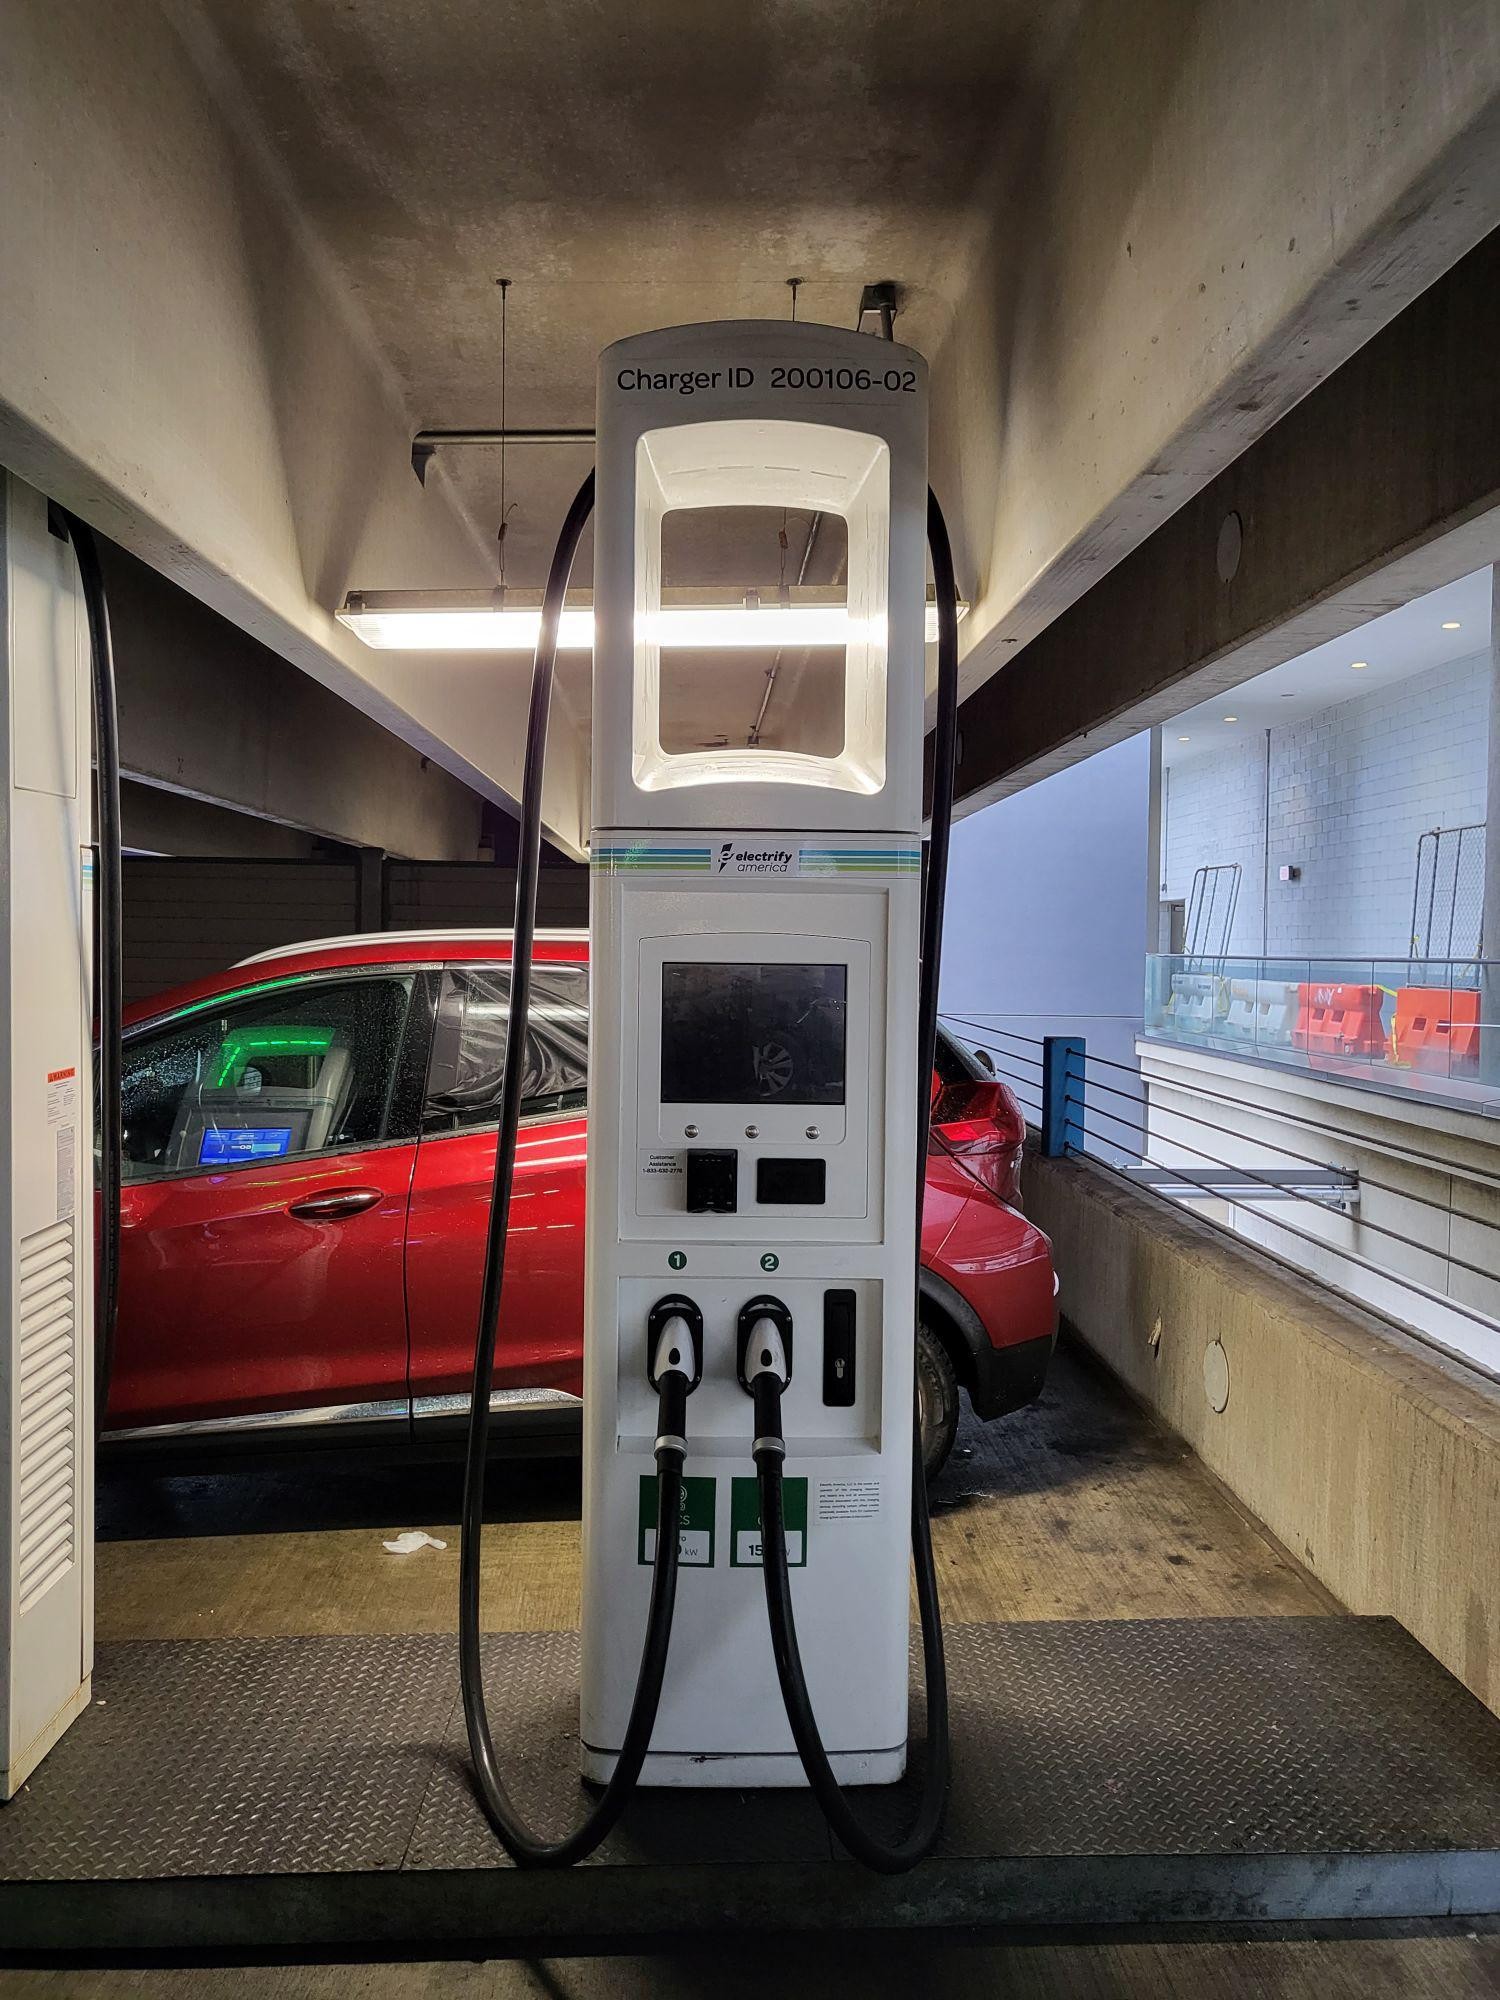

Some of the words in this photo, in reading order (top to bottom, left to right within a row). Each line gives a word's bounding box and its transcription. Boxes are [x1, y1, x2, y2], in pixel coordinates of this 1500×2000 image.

[617, 368, 721, 395] Charger
[728, 368, 754, 388] ID
[770, 367, 916, 392] 200106-02
[736, 851, 793, 864] electrify
[737, 863, 788, 873] america
[684, 1548, 698, 1556] kW
[748, 1545, 765, 1557] 15
